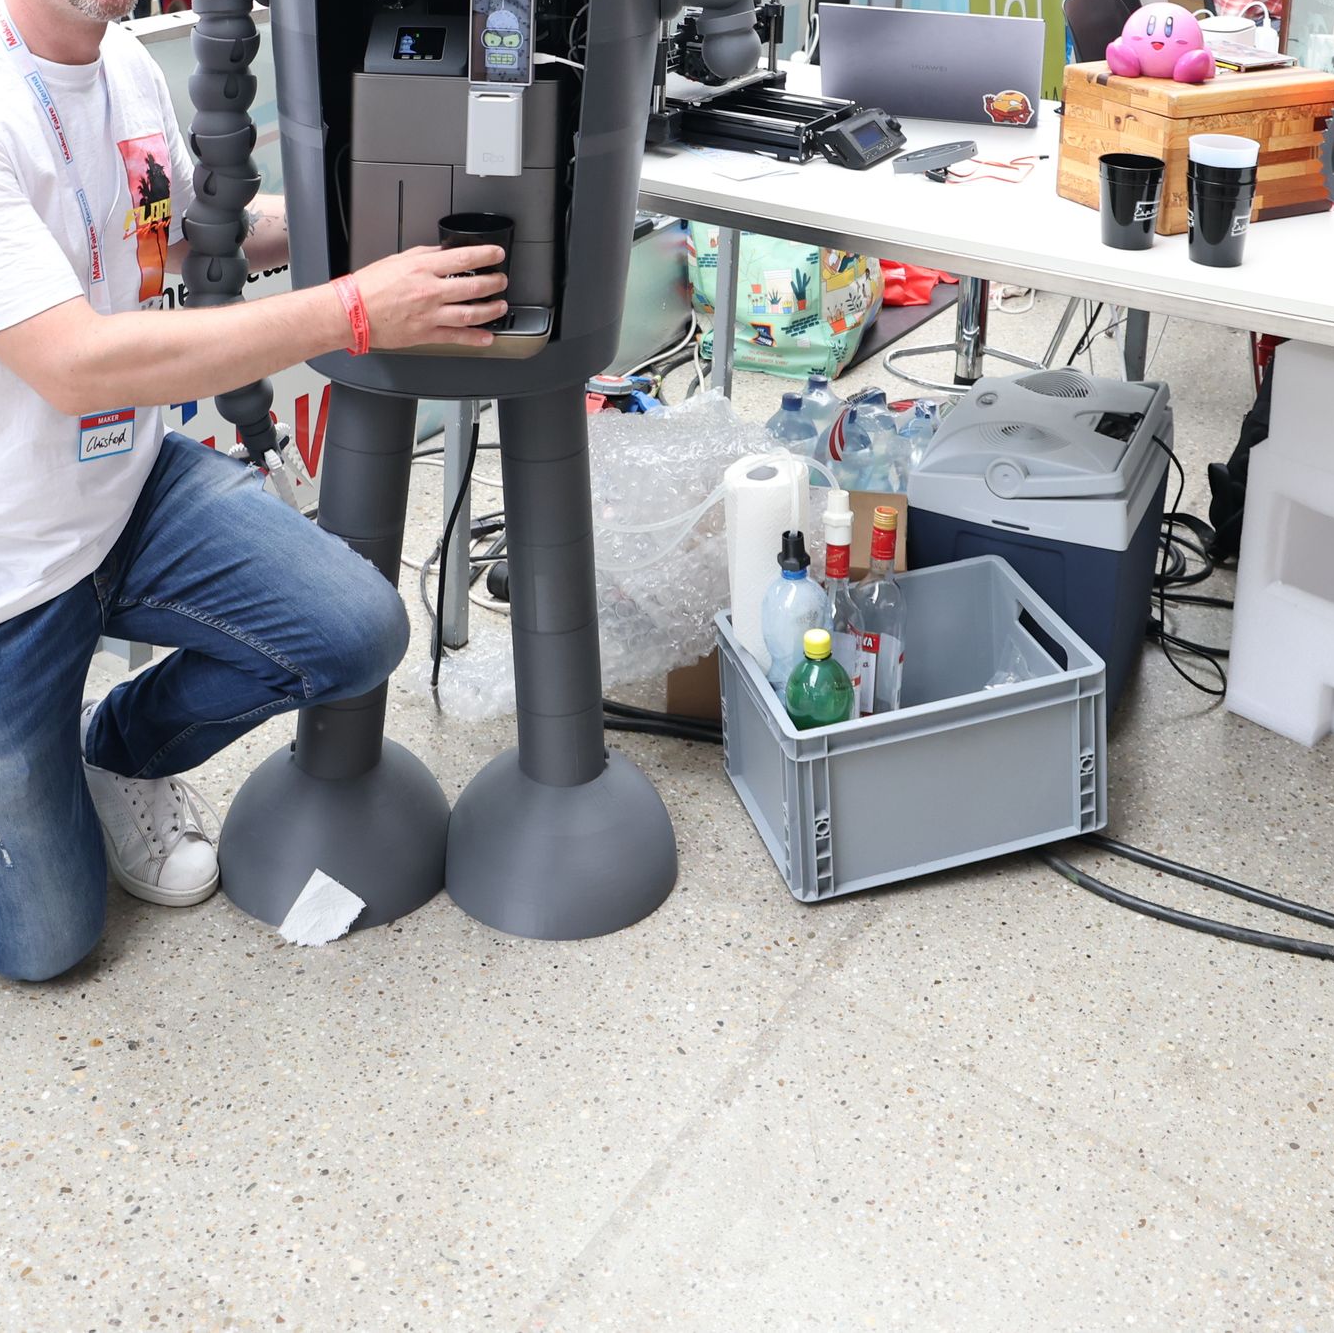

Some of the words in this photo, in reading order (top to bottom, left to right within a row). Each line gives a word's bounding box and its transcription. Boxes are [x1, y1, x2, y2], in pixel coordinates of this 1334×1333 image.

[0, 19, 19, 48] Maker
[911, 63, 948, 73] HUAWEI
[30, 75, 51, 108] Vienna
[48, 106, 62, 131] Faire
[56, 131, 71, 162] Maker
[78, 192, 92, 226] Vienna
[89, 225, 99, 250] Faire
[91, 250, 103, 281] Maker
[353, 304, 363, 330] Faire
[97, 413, 120, 426] MAKER
